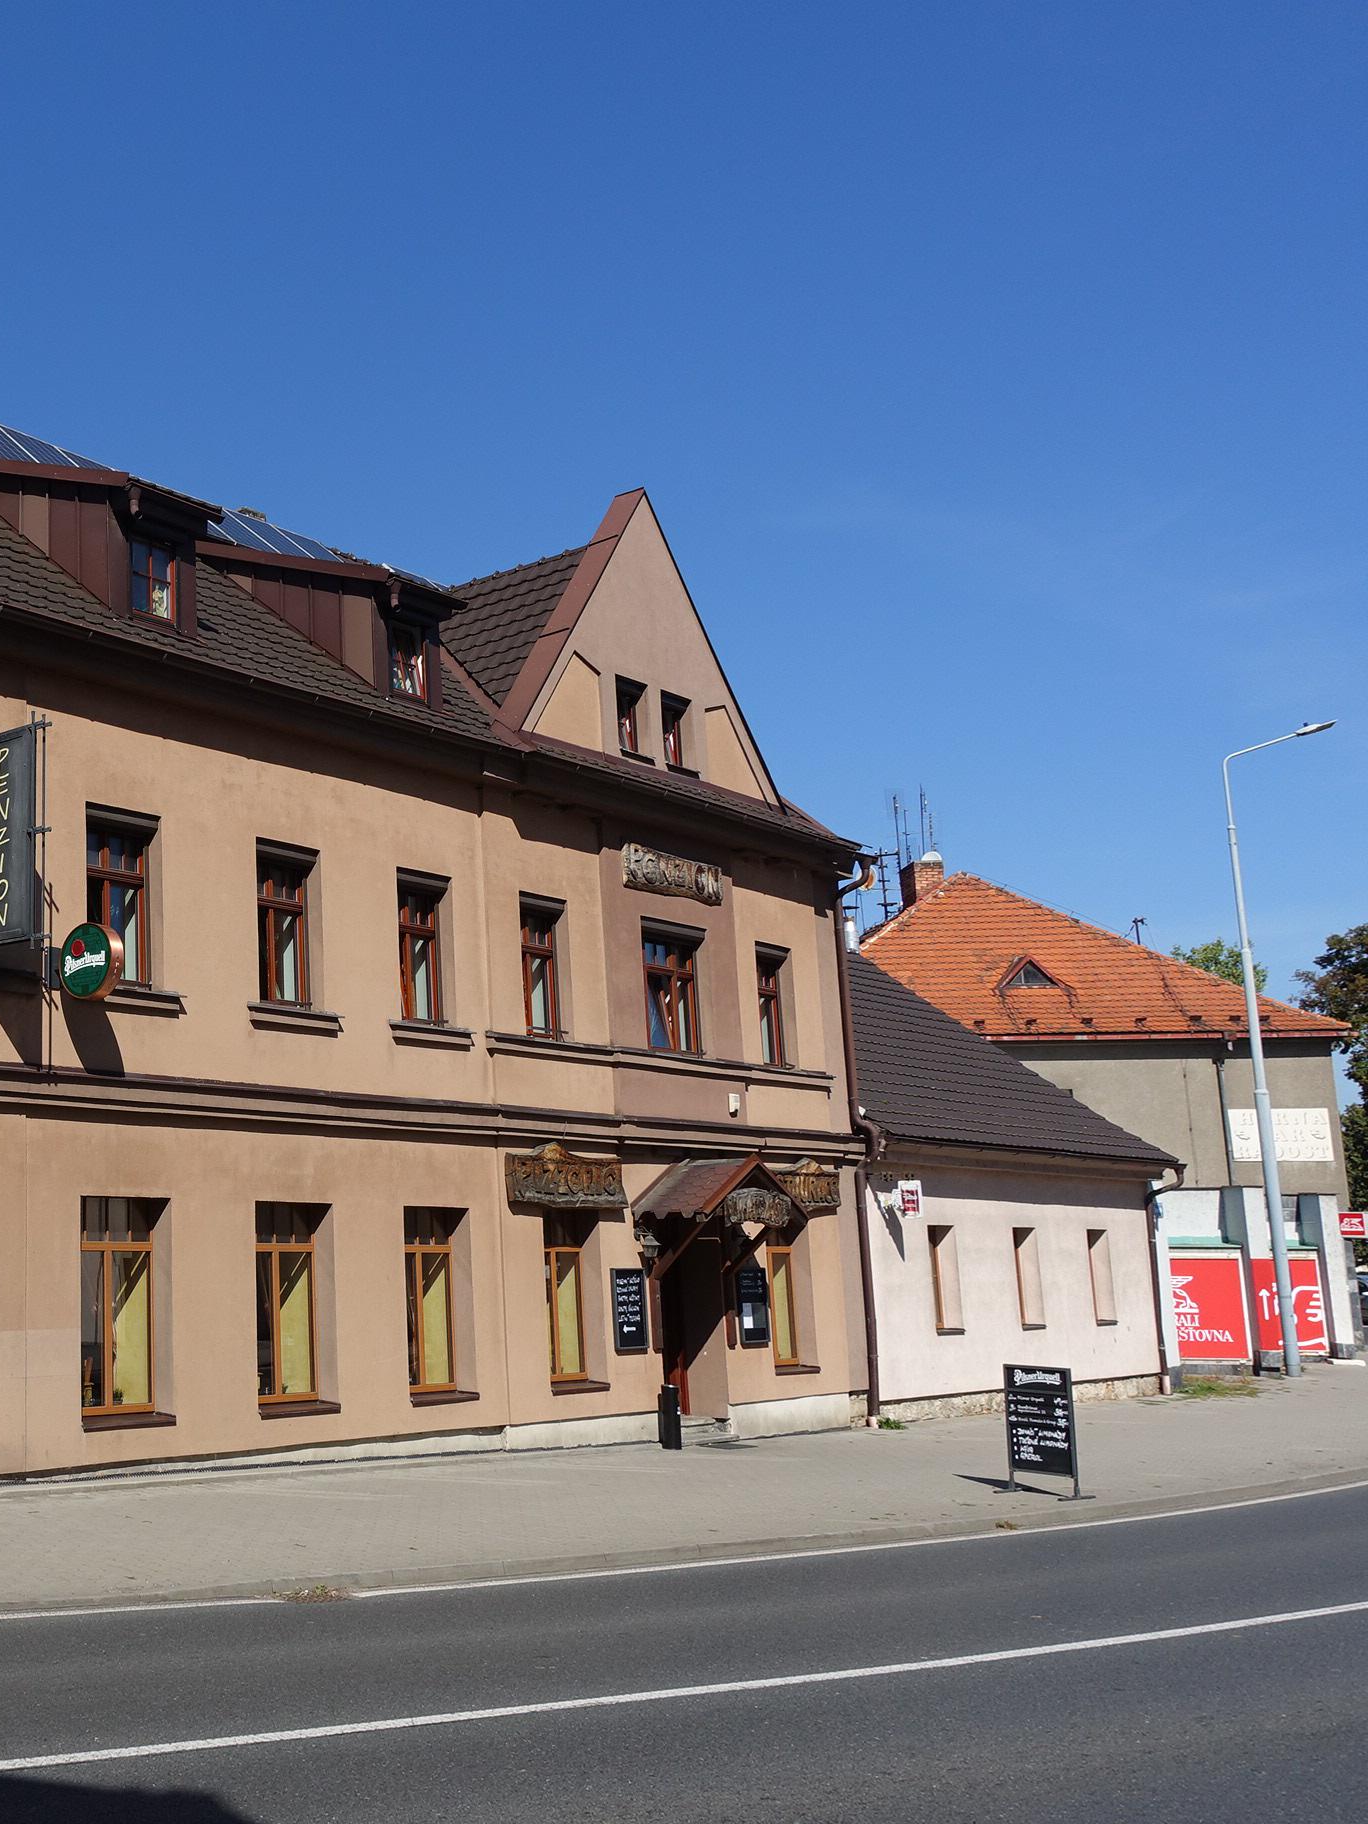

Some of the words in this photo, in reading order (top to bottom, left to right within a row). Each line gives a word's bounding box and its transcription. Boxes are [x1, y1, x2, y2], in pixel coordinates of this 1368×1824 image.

[64, 955, 85, 976] Pilsner
[84, 950, 105, 967] Urquell
[1013, 1369, 1037, 1386] Pilsner
[1036, 1371, 1061, 1385] Urquell
